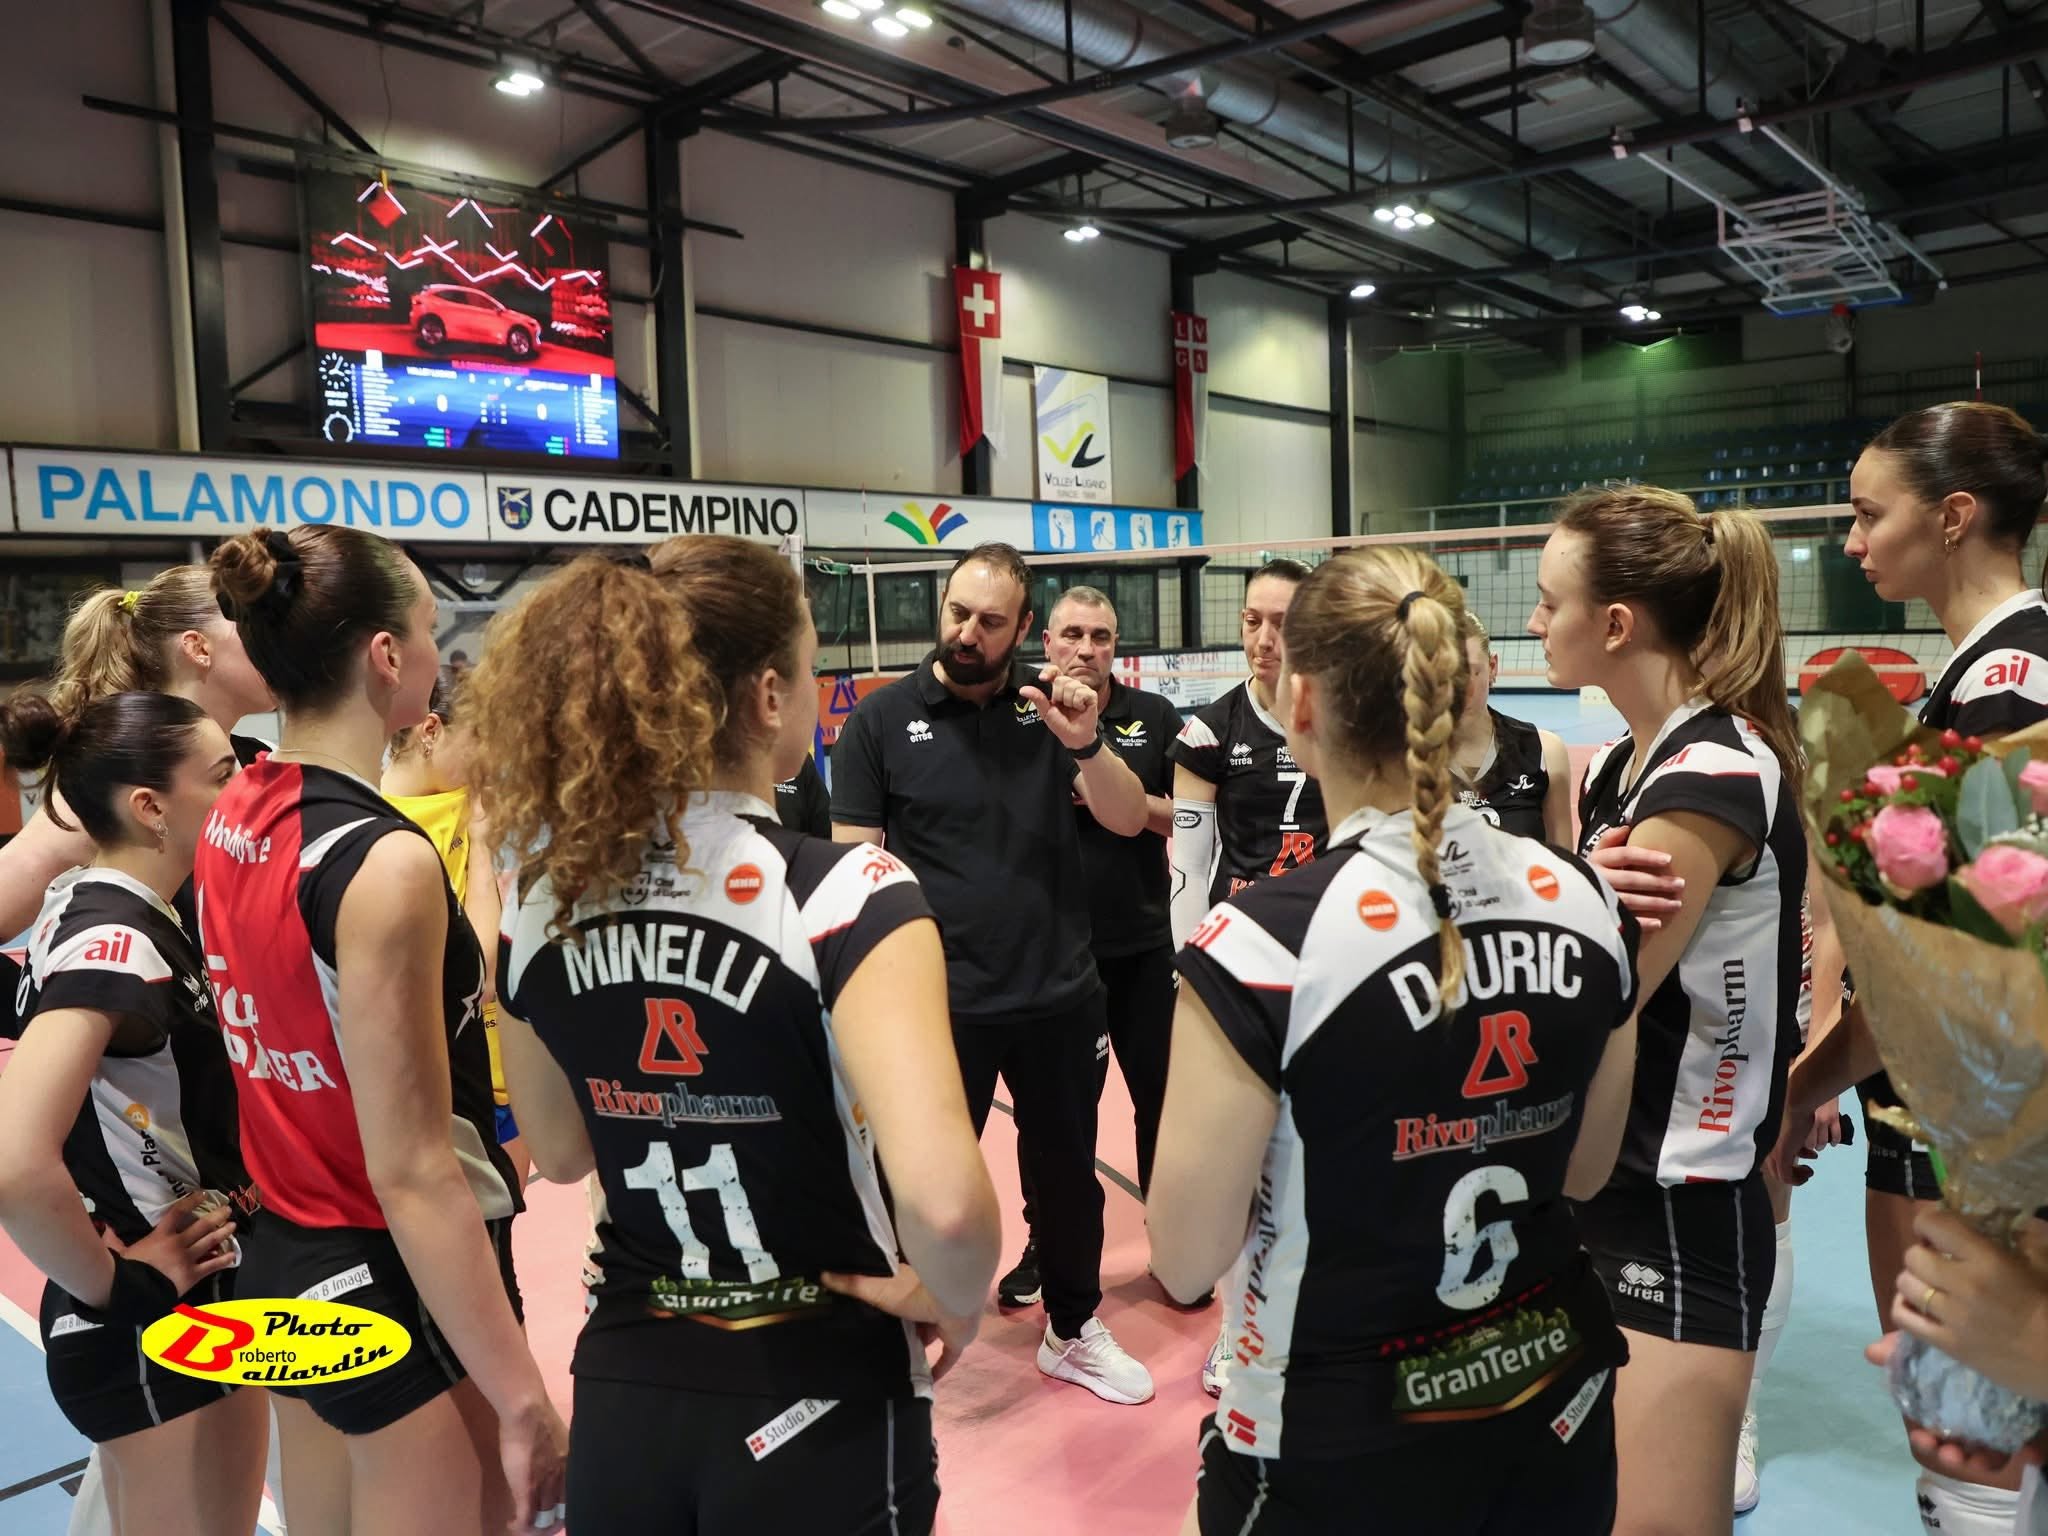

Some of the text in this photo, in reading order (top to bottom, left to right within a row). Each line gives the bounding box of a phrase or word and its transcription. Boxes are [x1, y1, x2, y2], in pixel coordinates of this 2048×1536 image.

[37, 465, 470, 528] PALAMONDO
[544, 488, 798, 536] CADEMPINO
[1984, 654, 2030, 687] ail
[1277, 771, 1307, 823] 7
[84, 931, 132, 964] ail
[562, 921, 771, 1014] MINELLI
[1697, 957, 1749, 1137] Rivopharm
[585, 1077, 782, 1129] Rivopharm
[623, 1141, 781, 1286] 11
[1436, 1165, 1530, 1311] 6
[332, 1268, 370, 1293] Image
[1618, 1281, 1665, 1304] errea
[1405, 1326, 1569, 1406] GranTerre
[765, 1410, 806, 1443] Studio
